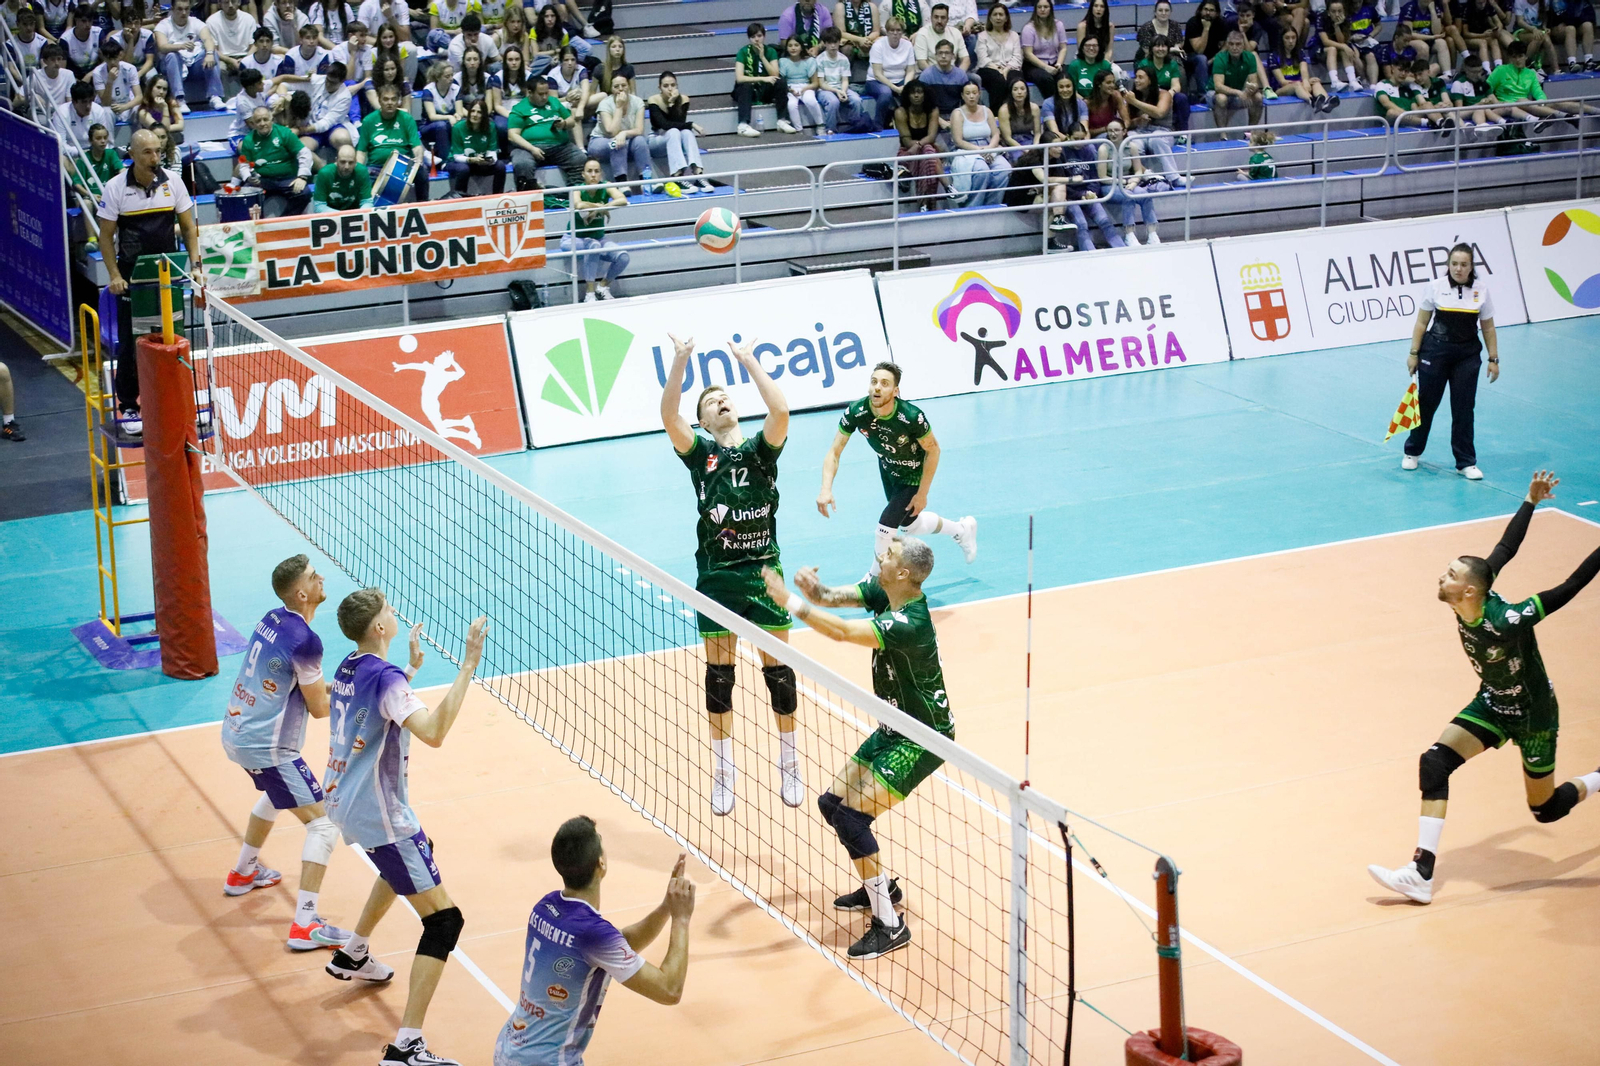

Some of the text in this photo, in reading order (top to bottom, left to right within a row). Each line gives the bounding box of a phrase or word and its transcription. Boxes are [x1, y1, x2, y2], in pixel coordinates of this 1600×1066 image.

[114, 87, 121, 96] 6
[311, 207, 428, 248] PEÑA
[266, 236, 476, 289] LA UNION
[1324, 235, 1493, 294] ALMERA
[1034, 294, 1175, 331] COSTA DE
[1328, 294, 1415, 325] CIUDAD
[652, 322, 866, 393] Unicaja
[1014, 323, 1187, 382] ALMERÍA
[194, 374, 336, 440] VM
[256, 438, 330, 466] VOLEIBOL
[333, 428, 421, 456] MASCULINA
[729, 466, 750, 488] 12
[732, 502, 771, 522] Unicaj
[245, 640, 263, 678] 9
[538, 918, 575, 949] LORENTE
[524, 936, 541, 984] 5
